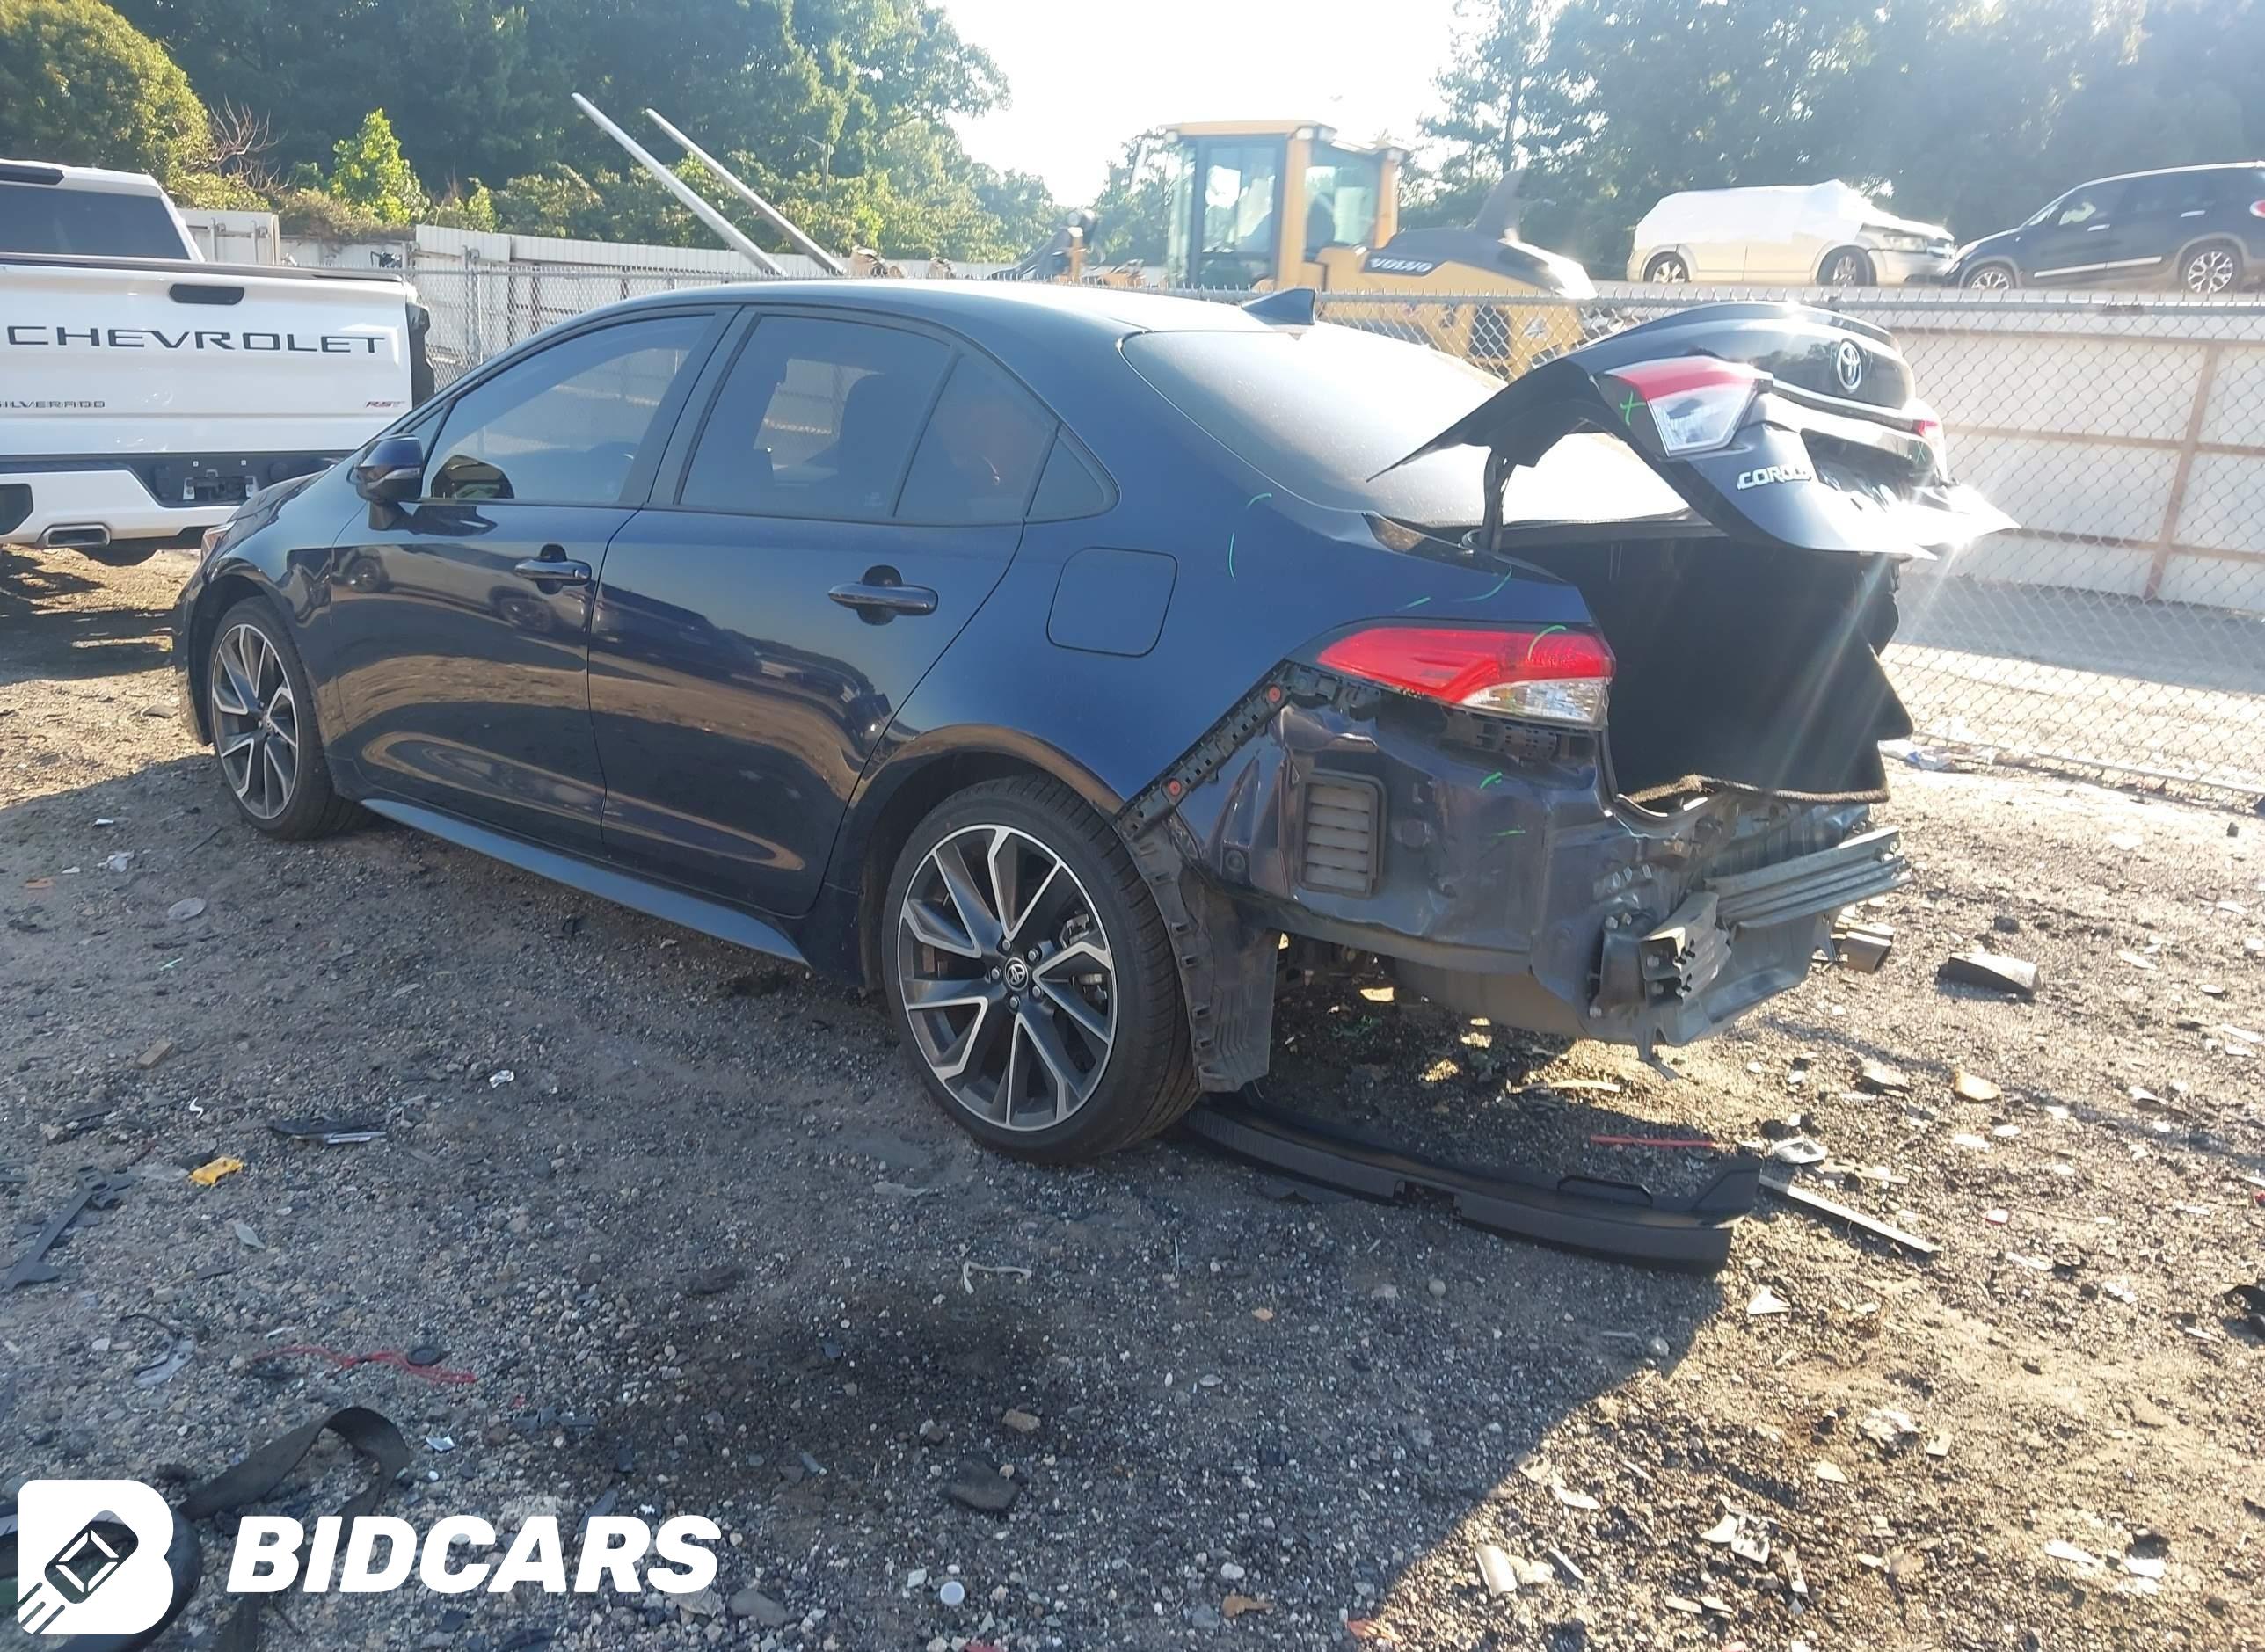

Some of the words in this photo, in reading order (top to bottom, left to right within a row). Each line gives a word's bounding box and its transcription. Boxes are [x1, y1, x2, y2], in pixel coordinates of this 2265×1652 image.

[1370, 258, 1434, 273] VOLVO
[7, 325, 385, 353] CHEVROLET
[0, 400, 106, 409] ILVERADO
[365, 400, 405, 409] RST
[1737, 464, 1813, 491] CORO
